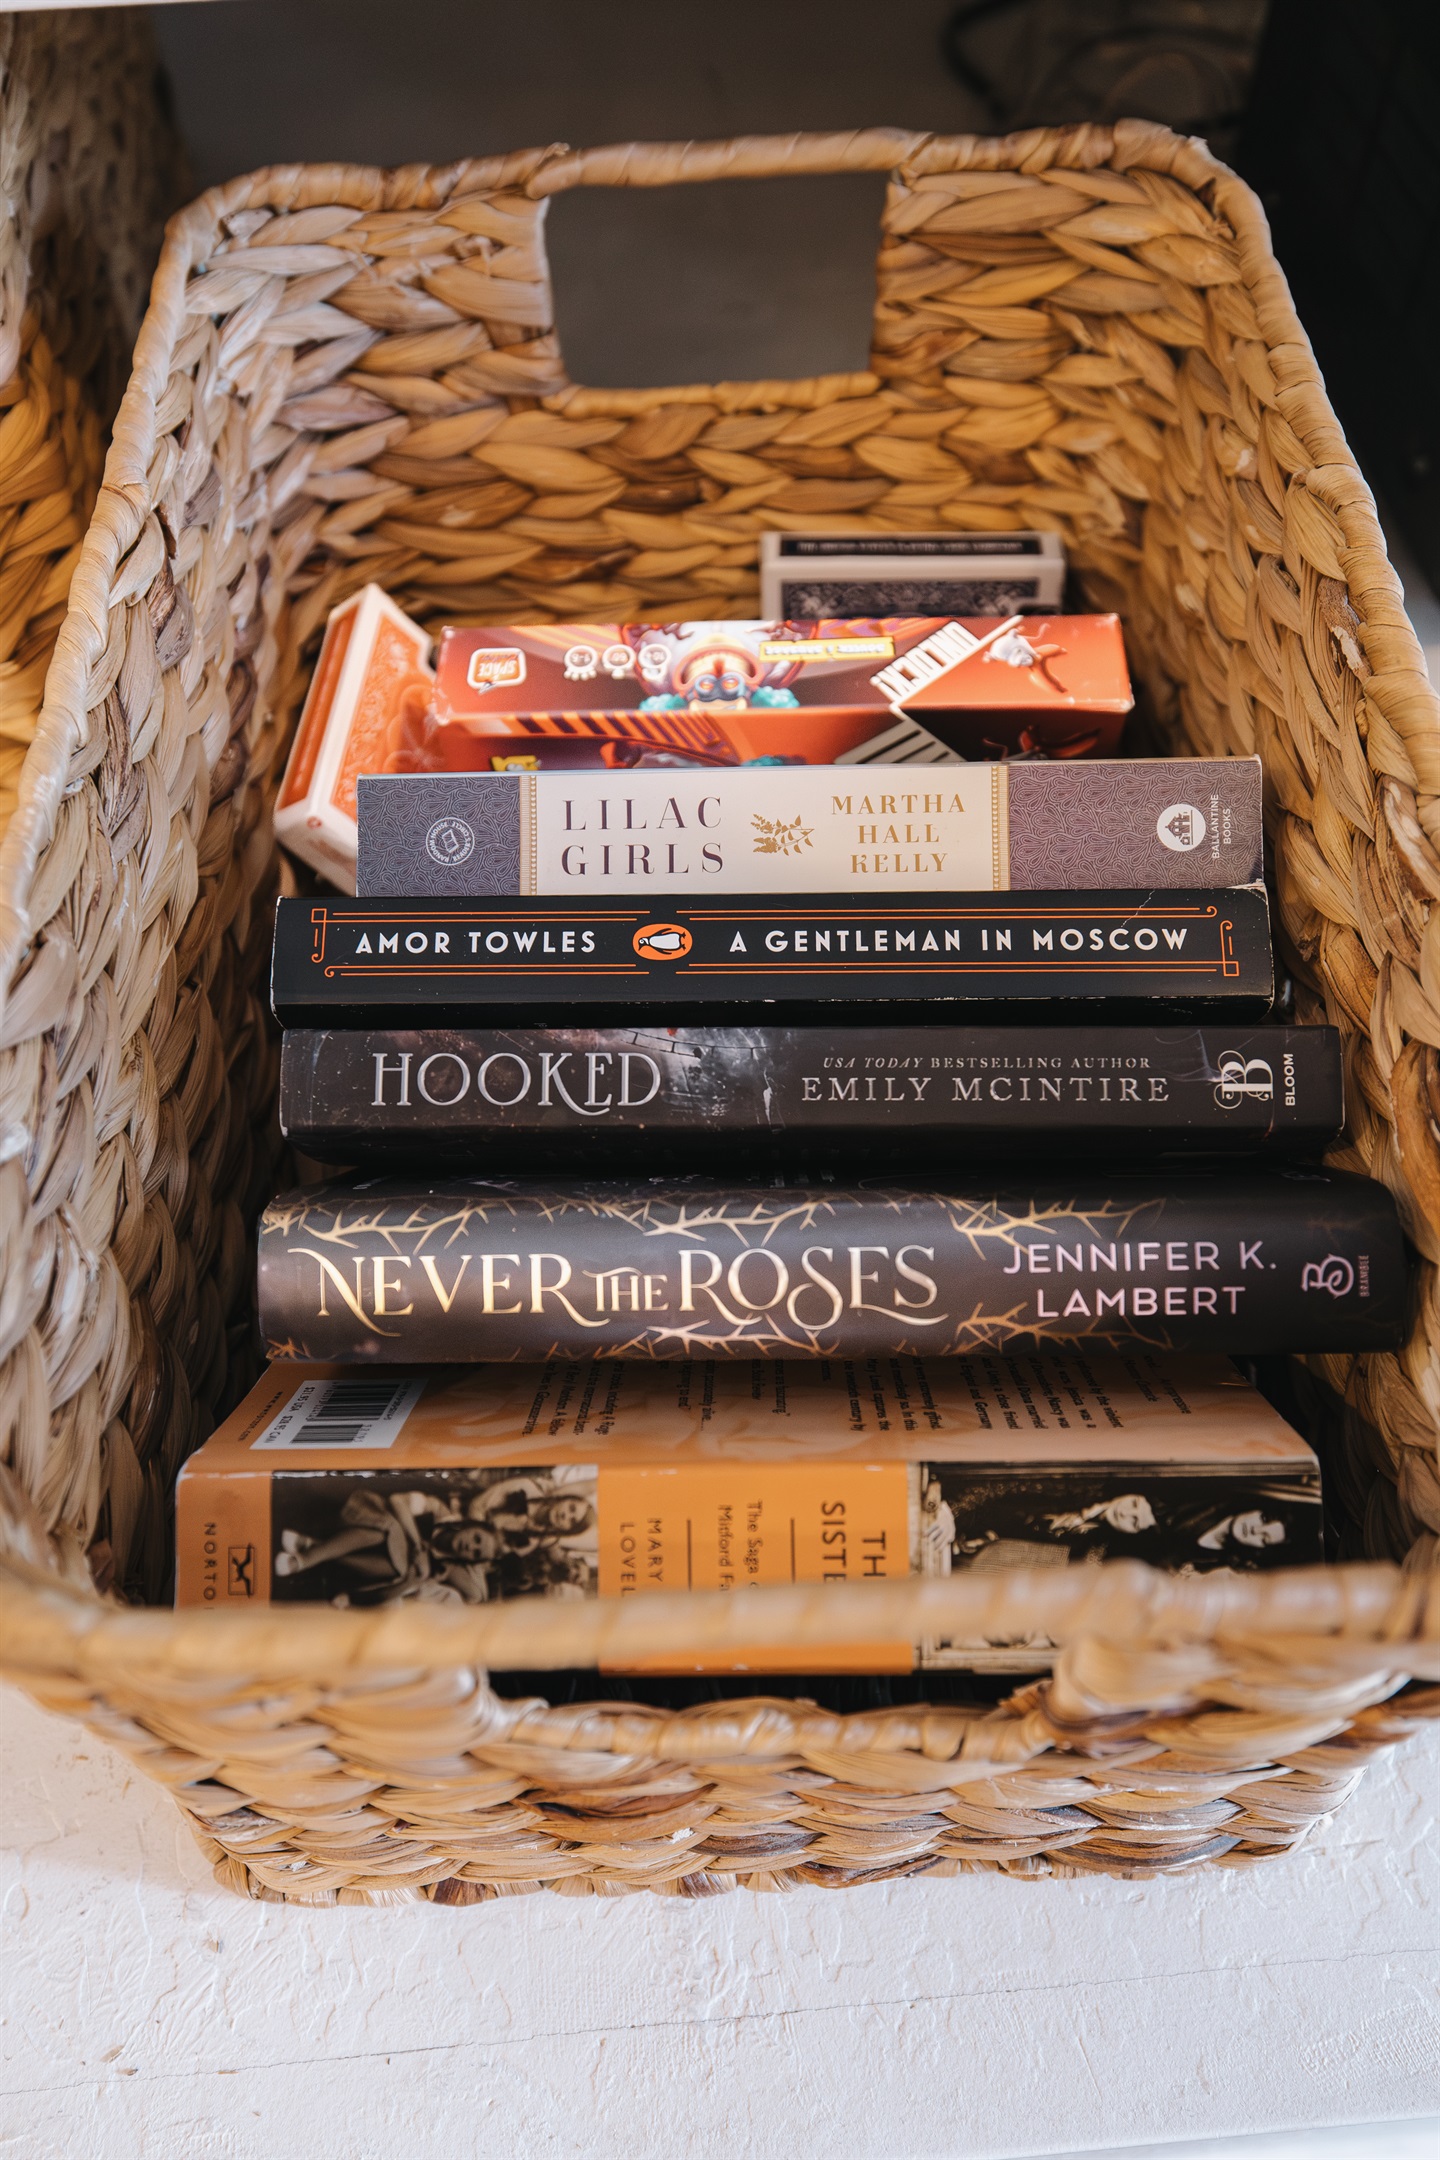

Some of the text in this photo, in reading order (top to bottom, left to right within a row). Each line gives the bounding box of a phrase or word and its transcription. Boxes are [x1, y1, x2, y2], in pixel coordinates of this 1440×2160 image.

[477, 659, 518, 678] SPACE
[869, 621, 980, 701] UNLOCK!
[563, 796, 723, 831] LILAC
[831, 793, 966, 815] MARTHA
[429, 820, 449, 863] RANDOM HOUSE
[858, 823, 941, 844] HALL
[1211, 794, 1220, 859] BALLANTINE
[1223, 808, 1231, 844] BOOKS
[561, 843, 724, 876] GIRLS
[850, 852, 949, 874] KELLY
[355, 930, 596, 954] AMOR TOWLES
[729, 927, 1188, 953] A GENTLEMAN IN MOSCOW
[823, 1057, 1152, 1069] USA TODAY BESTSELLING AUTHOR
[371, 1052, 662, 1116] HOOKED
[801, 1077, 1170, 1102] EMILY MCINTIRE
[1283, 1053, 1296, 1107] BLOOM
[1003, 1240, 1278, 1275] JENNIFER K.
[287, 1244, 949, 1336] NEVER THE ROSES
[1037, 1286, 1246, 1318] LAMBERT
[560, 1371, 581, 1384] Beryl
[289, 1402, 304, 1412] USA
[297, 1386, 316, 1402] $21.95
[599, 1391, 620, 1415] including
[843, 1360, 867, 1432] the twentieth century by
[864, 1358, 892, 1431] Mary Lovell captures the
[918, 1381, 939, 1410] extremely
[969, 1388, 986, 1400] and
[996, 1393, 1011, 1410] close
[1017, 1387, 1033, 1404] Diana
[1025, 1404, 1050, 1429] married
[1096, 1396, 1111, 1406] the
[548, 1418, 566, 1436] fellow
[904, 1419, 918, 1431] this
[974, 1401, 993, 1431] Germany
[1003, 1410, 1024, 1430] friend
[1047, 1396, 1064, 1416] Nancy
[1057, 1417, 1071, 1429] was
[1079, 1408, 1092, 1421] was
[1103, 1406, 1125, 1428] violent
[747, 1500, 763, 1532] The
[647, 1517, 663, 1582] MARY
[717, 1504, 734, 1567] Mitford
[821, 1500, 847, 1584] SISTE
[203, 1522, 218, 1601] NORTO
[619, 1521, 636, 1597] LOVEL
[743, 1537, 764, 1574] Saga
[862, 1529, 886, 1577] TH
